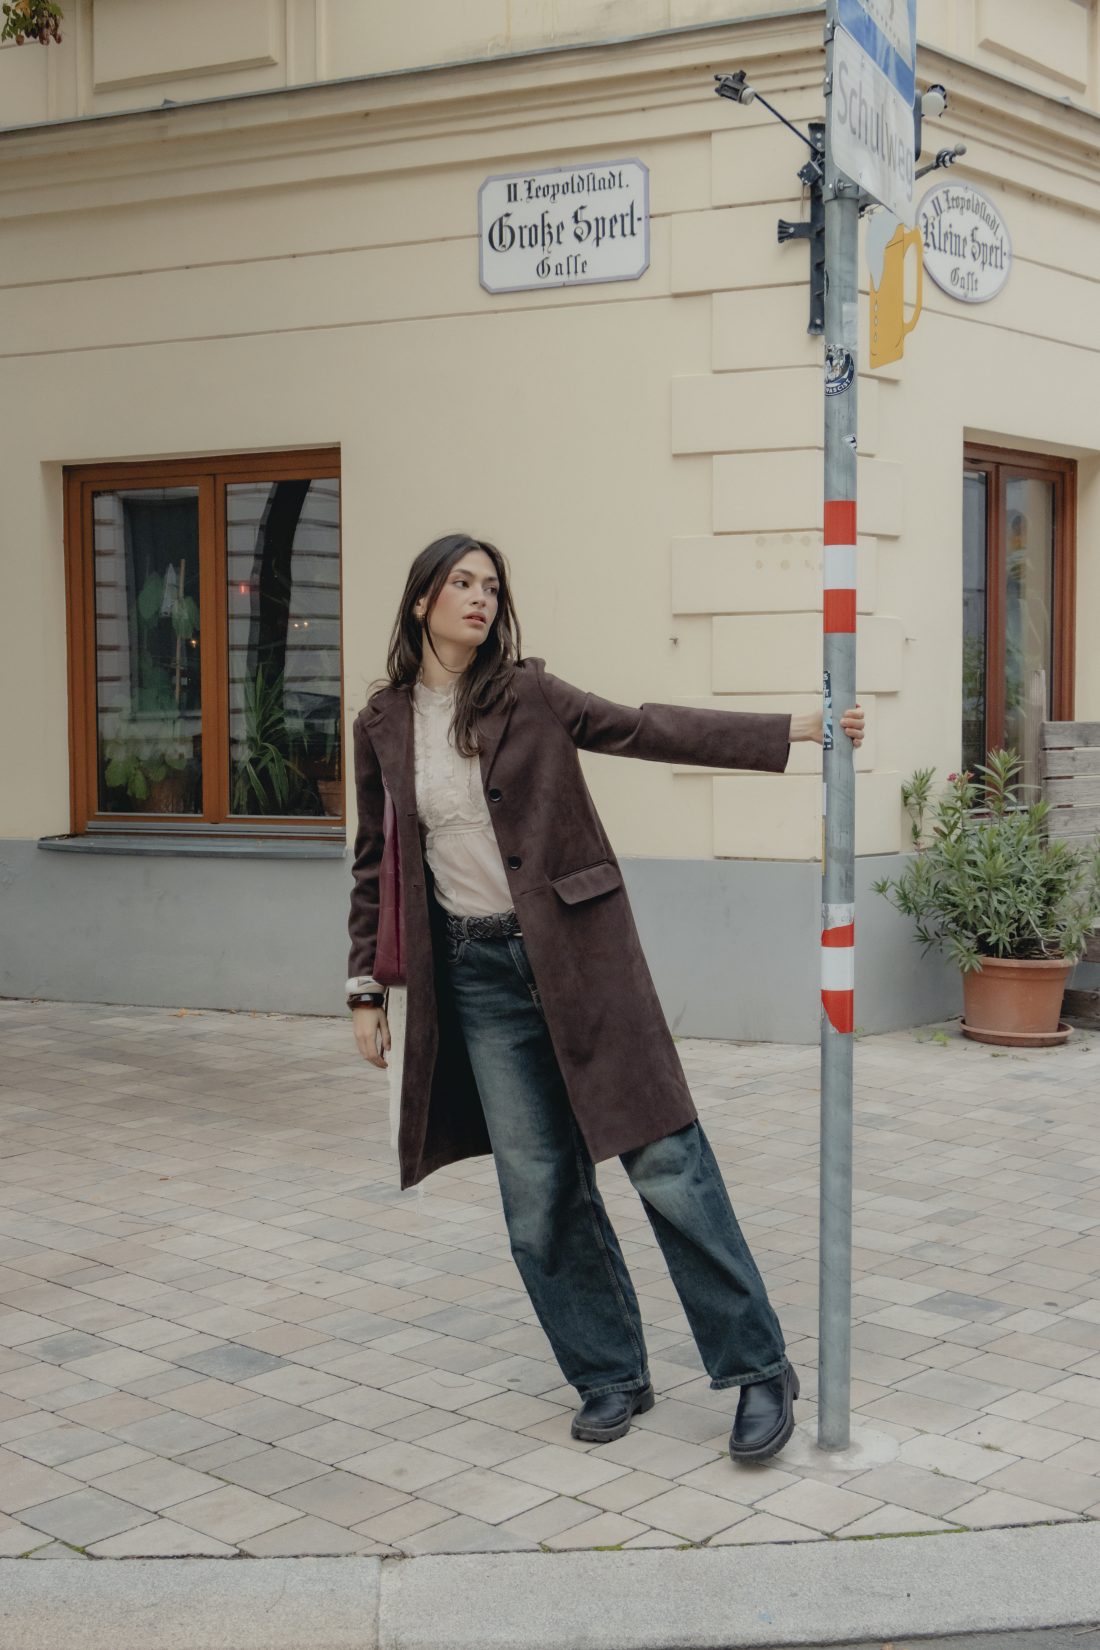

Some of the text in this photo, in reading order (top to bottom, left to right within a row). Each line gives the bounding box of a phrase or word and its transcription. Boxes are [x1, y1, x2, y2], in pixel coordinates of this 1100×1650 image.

[837, 59, 914, 203] Schulweg
[506, 182, 523, 203] II.
[488, 199, 642, 254] Große Sperl-
[923, 212, 967, 260] Kleine
